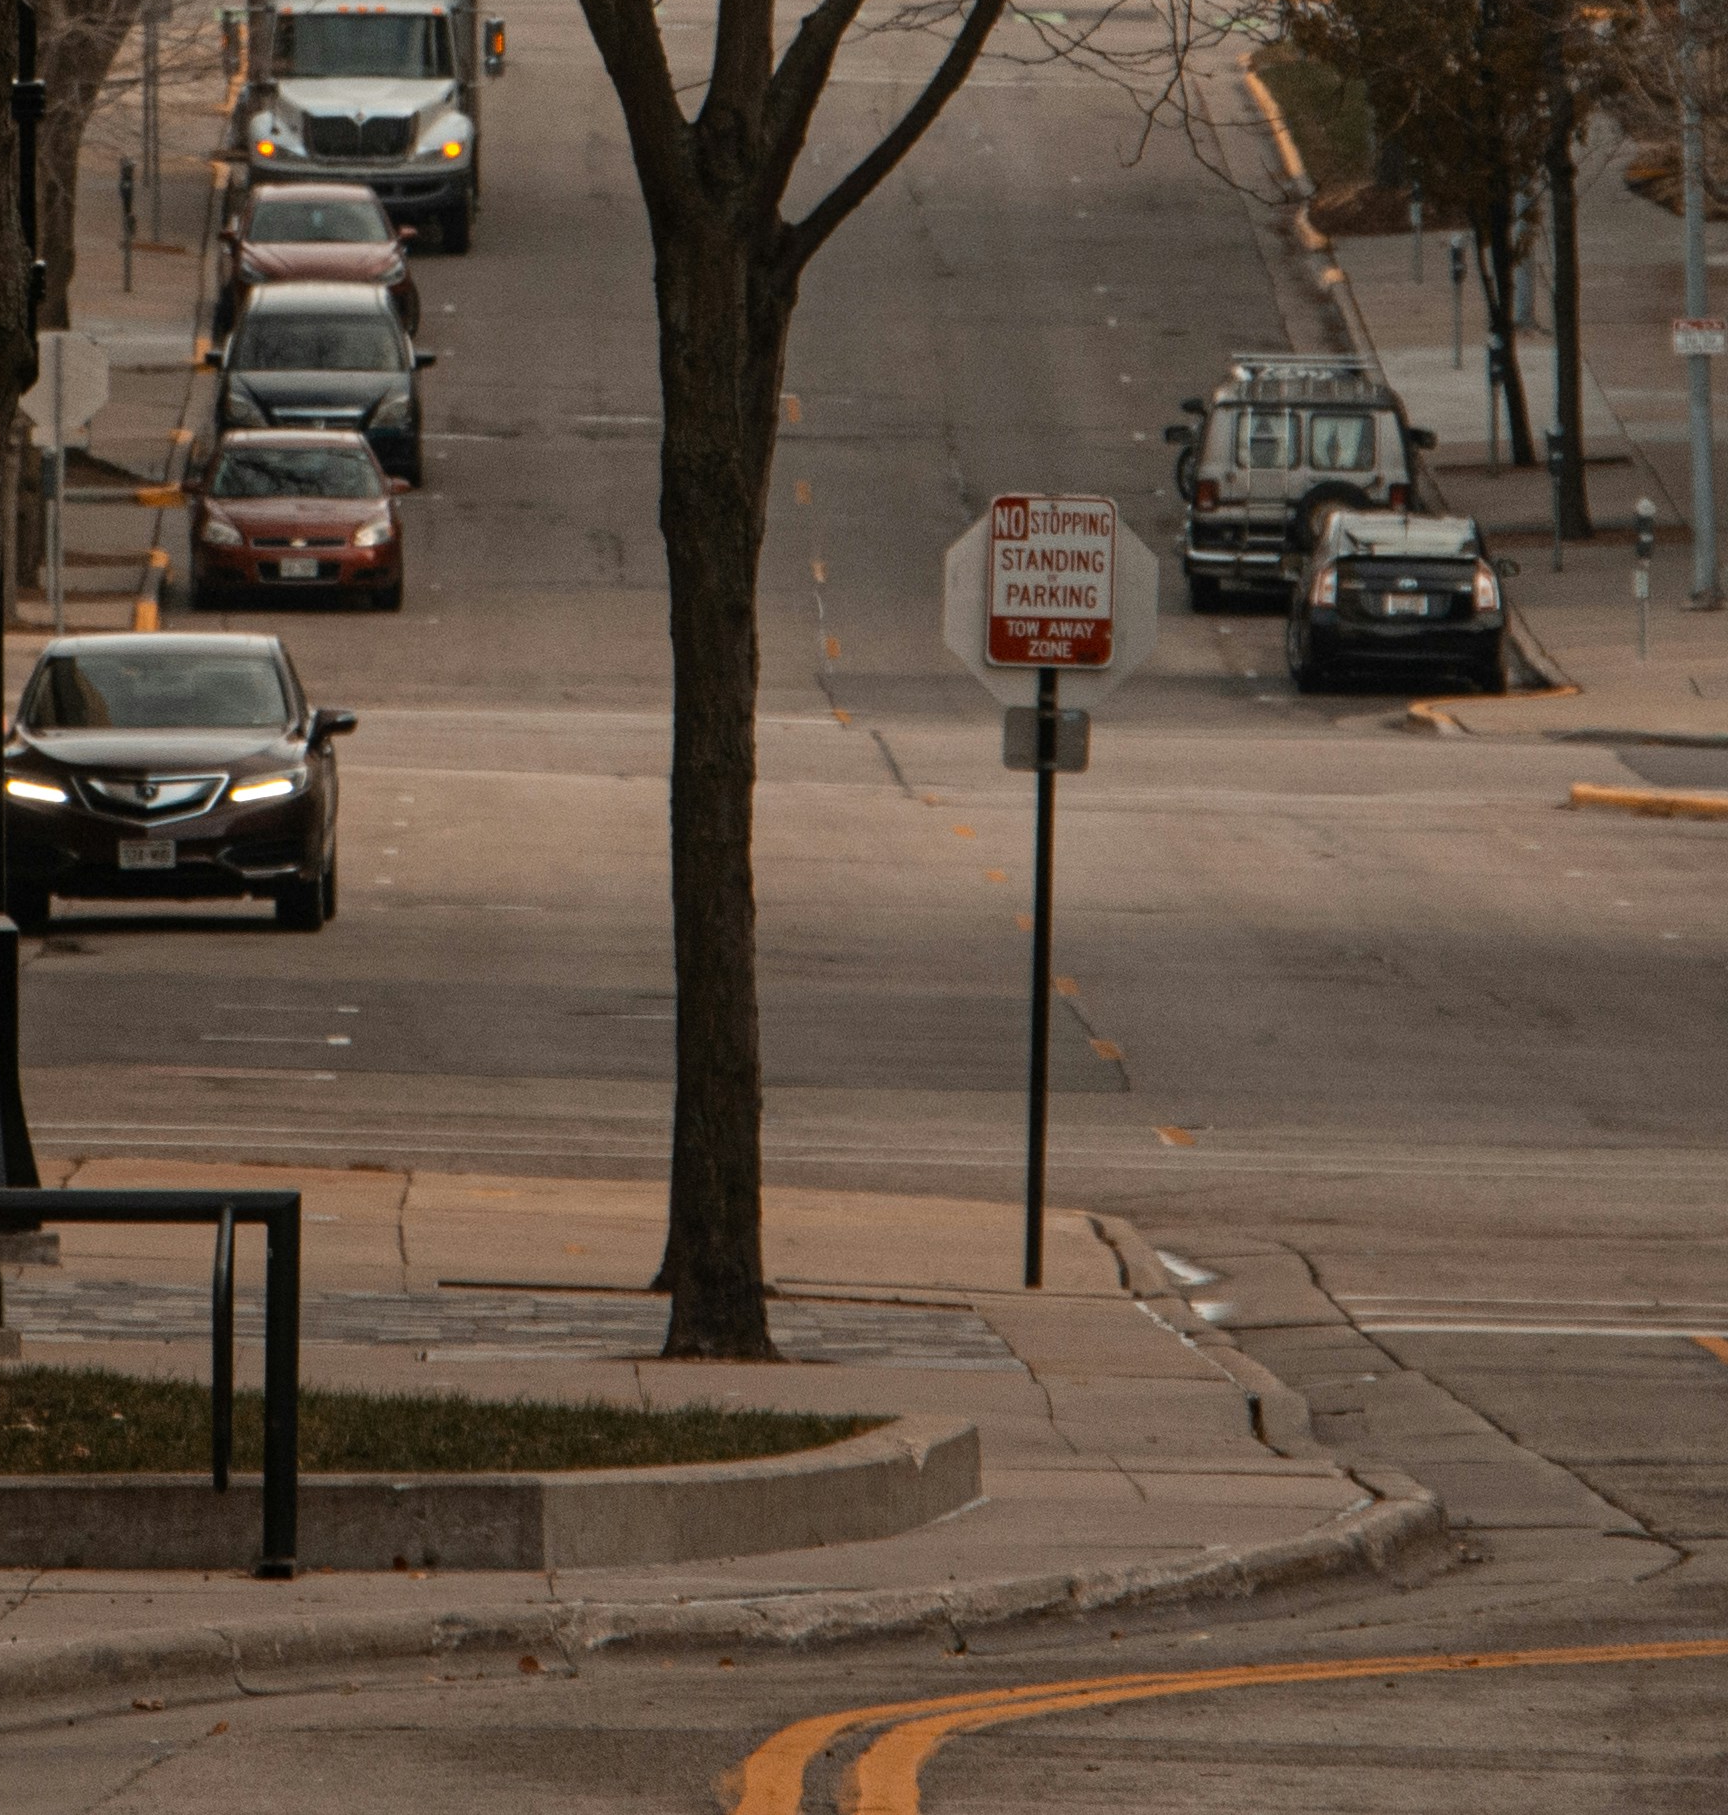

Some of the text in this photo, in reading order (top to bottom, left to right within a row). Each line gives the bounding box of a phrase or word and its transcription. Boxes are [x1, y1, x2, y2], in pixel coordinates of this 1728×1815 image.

[995, 506, 1110, 537] NO STOPPING
[1001, 548, 1105, 573] STANDING
[1006, 584, 1098, 609] PARKING
[1006, 620, 1096, 639] TOW AWAY
[1028, 640, 1072, 659] ZONE
